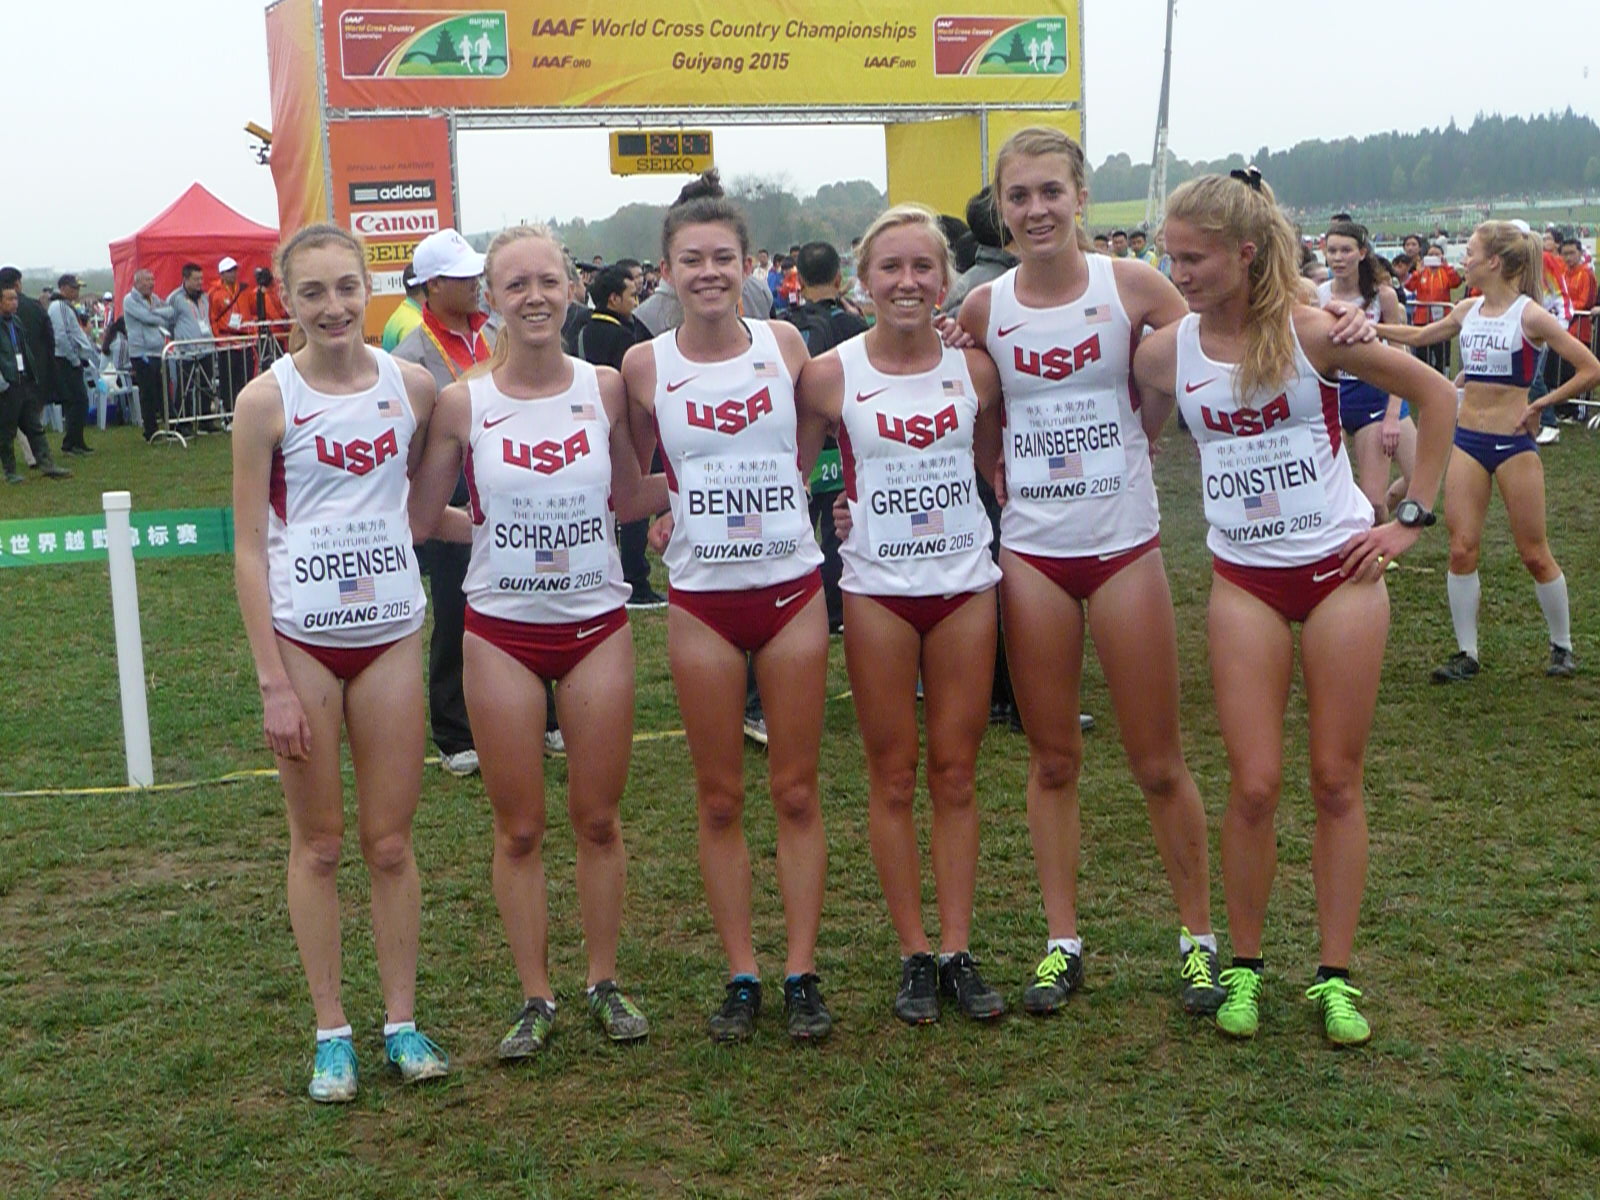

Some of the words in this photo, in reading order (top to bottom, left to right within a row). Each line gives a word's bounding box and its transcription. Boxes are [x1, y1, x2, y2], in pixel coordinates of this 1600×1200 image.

[531, 18, 586, 37] IAAF
[592, 18, 647, 37] World
[652, 19, 704, 37] Cross
[710, 19, 780, 42] Country
[785, 20, 917, 43] Championships
[672, 52, 744, 74] Guiyang
[749, 53, 790, 71] 2015
[636, 158, 694, 171] SEIKO
[380, 184, 431, 199] adidas
[355, 215, 435, 233] Canon
[367, 243, 415, 261] SEIK
[1014, 332, 1101, 381] USA
[1461, 334, 1509, 351] NUTTALL
[686, 385, 773, 436] USA
[1201, 392, 1291, 437] USA
[876, 403, 959, 450] USA
[1014, 422, 1121, 459] RAINSBERGER
[315, 427, 399, 476] USA
[502, 428, 591, 476] USA
[1020, 481, 1086, 499] GUIYANG
[1090, 475, 1121, 494] 2015
[1206, 456, 1318, 500] CONSTIEN
[689, 485, 796, 516] BENNER
[871, 479, 972, 515] GREGORY
[495, 517, 604, 549] SCHRADER
[1289, 511, 1322, 533] 2015
[0, 523, 198, 556] 世界越野标赛
[695, 542, 763, 560] GUIYANG
[766, 539, 797, 556] 2015
[878, 538, 946, 558] GUIYANG
[949, 532, 974, 551] 2015
[294, 544, 408, 583] SORENSEN
[499, 576, 571, 592] GUIYANG
[574, 570, 603, 588] 2015
[303, 605, 378, 629] GUIYANG
[382, 600, 411, 620] 2015
